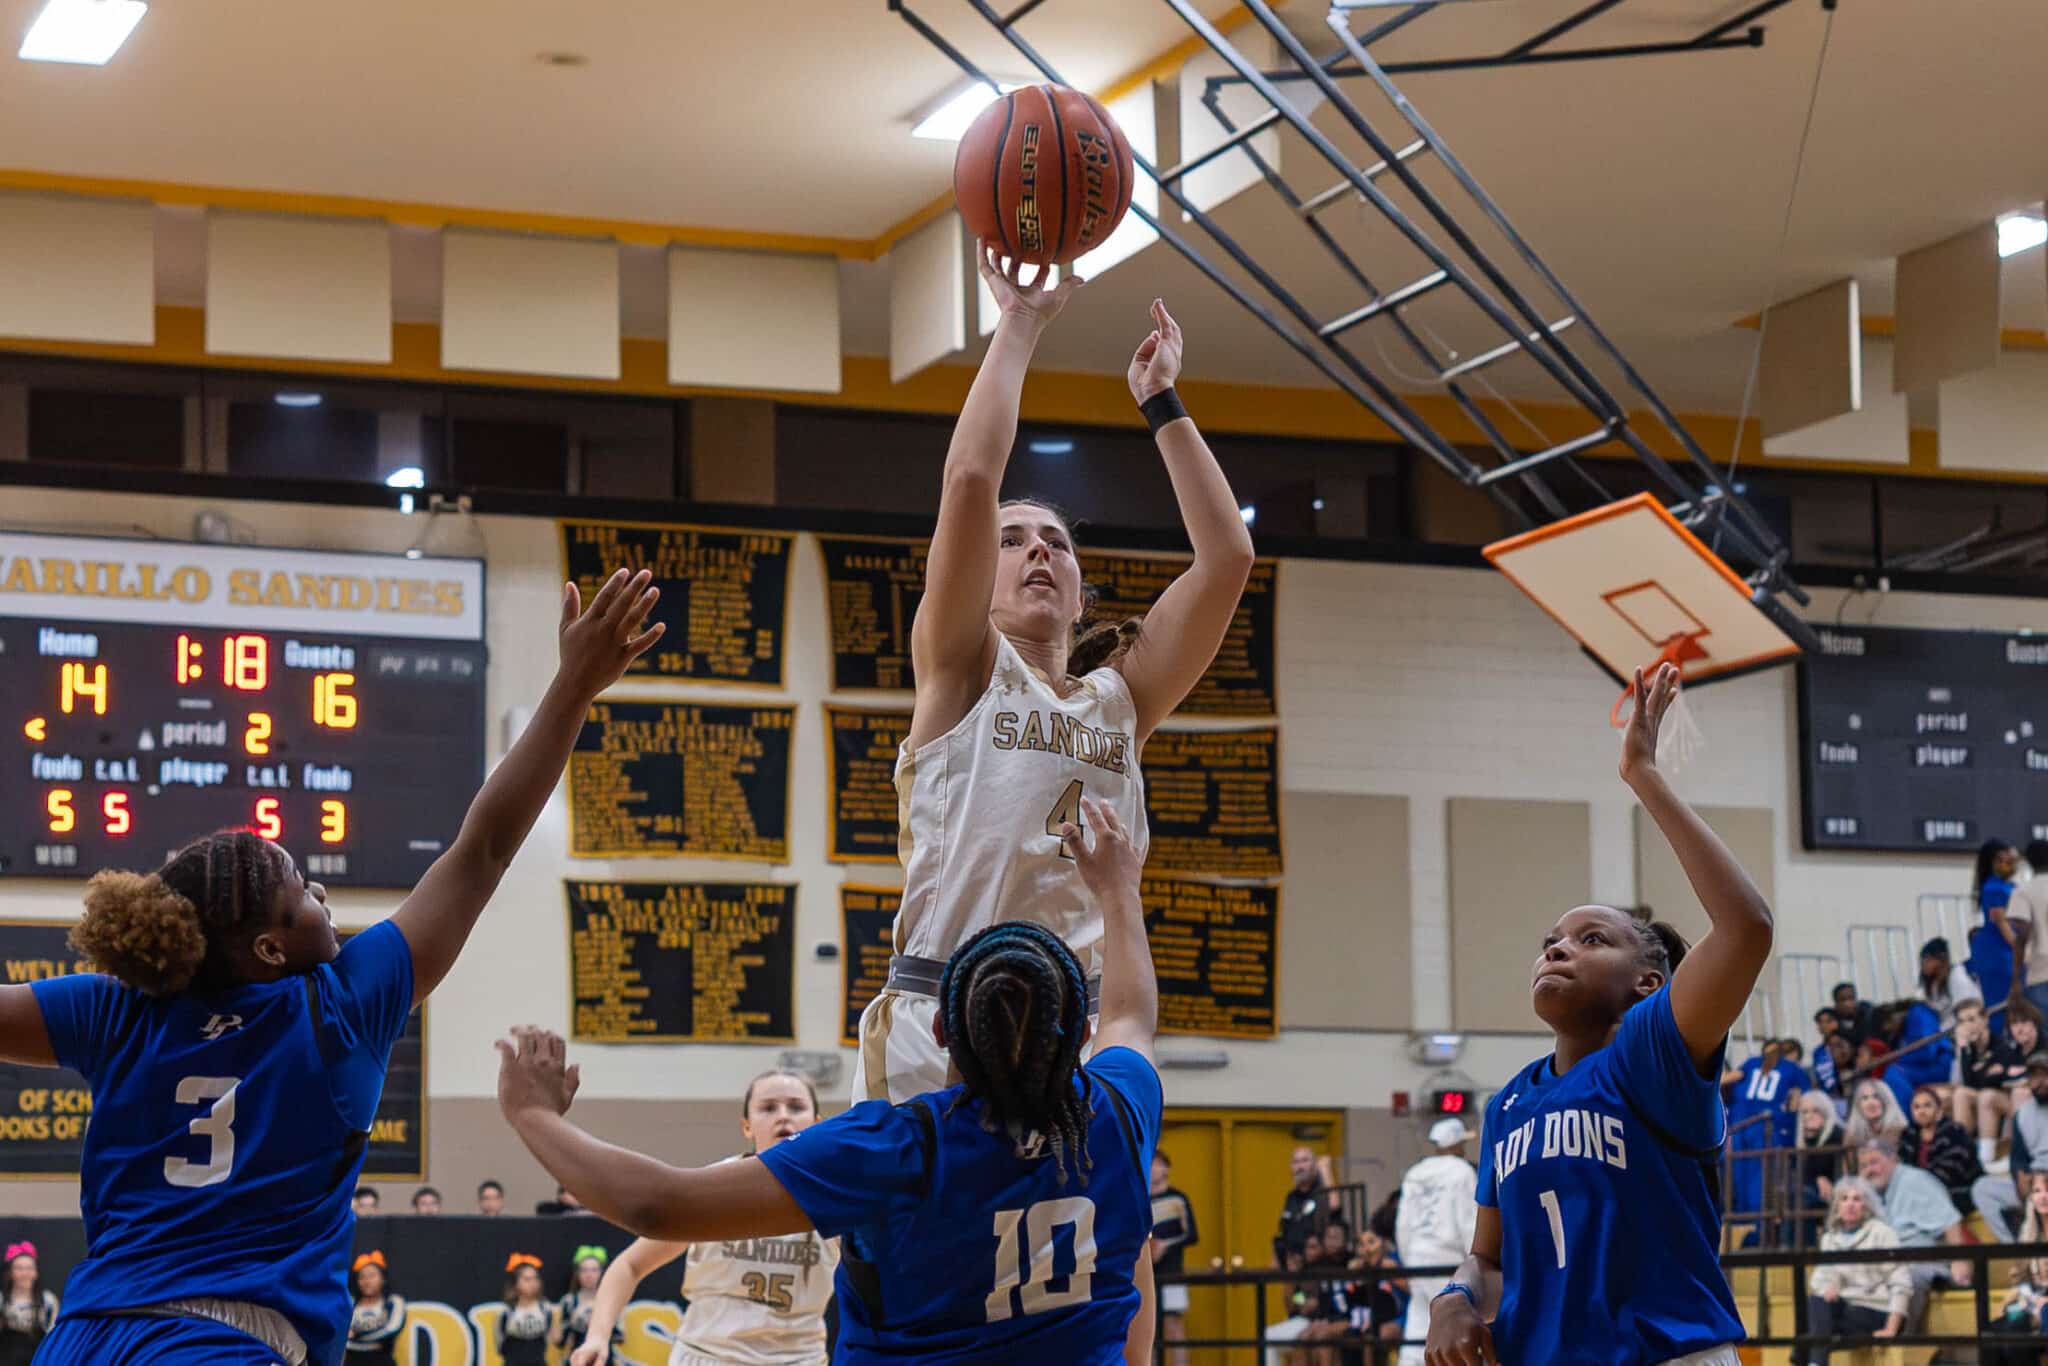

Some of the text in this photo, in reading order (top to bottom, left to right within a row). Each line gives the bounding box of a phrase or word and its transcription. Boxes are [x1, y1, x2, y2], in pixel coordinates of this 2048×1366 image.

[0, 556, 464, 617] ARILLO SANDIES
[39, 626, 98, 657] Home
[176, 634, 268, 690] 1:18
[61, 662, 107, 714] 14
[313, 672, 357, 728] 16
[162, 712, 272, 754] period 2
[32, 752, 83, 780] fouls
[160, 757, 229, 788] player
[303, 762, 353, 792] fouls
[47, 789, 75, 832] 5
[103, 792, 130, 834] 5
[255, 798, 281, 840] 5
[320, 800, 345, 842] 3
[1046, 779, 1084, 859] 4
[19, 1090, 92, 1113] OF SCH
[1746, 1067, 1781, 1101] 10
[54, 1115, 83, 1140] OF
[370, 1119, 407, 1142] AME
[164, 1076, 242, 1188] 3
[1541, 1109, 1627, 1170] DONS
[1539, 1189, 1566, 1269] 1
[985, 1196, 1097, 1323] 10
[741, 1271, 794, 1313] 35
